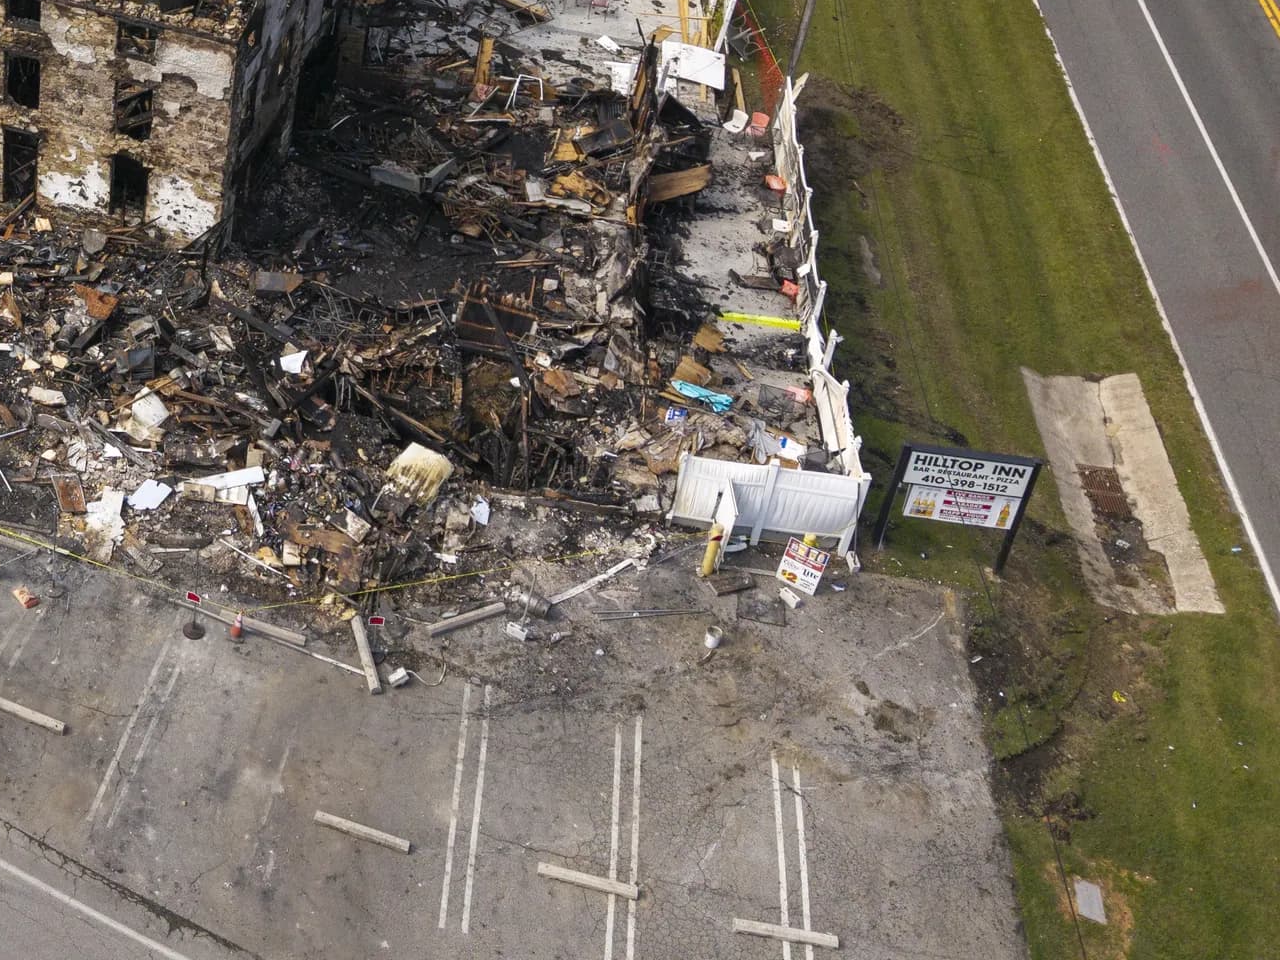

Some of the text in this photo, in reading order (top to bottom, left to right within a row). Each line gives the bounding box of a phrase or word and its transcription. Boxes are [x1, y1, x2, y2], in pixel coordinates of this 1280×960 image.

[914, 454, 1026, 479] HILLTOP INN
[921, 475, 1008, 493] 410-398-1512
[937, 468, 990, 481] RESTAURANT
[996, 477, 1020, 485] PIZZA
